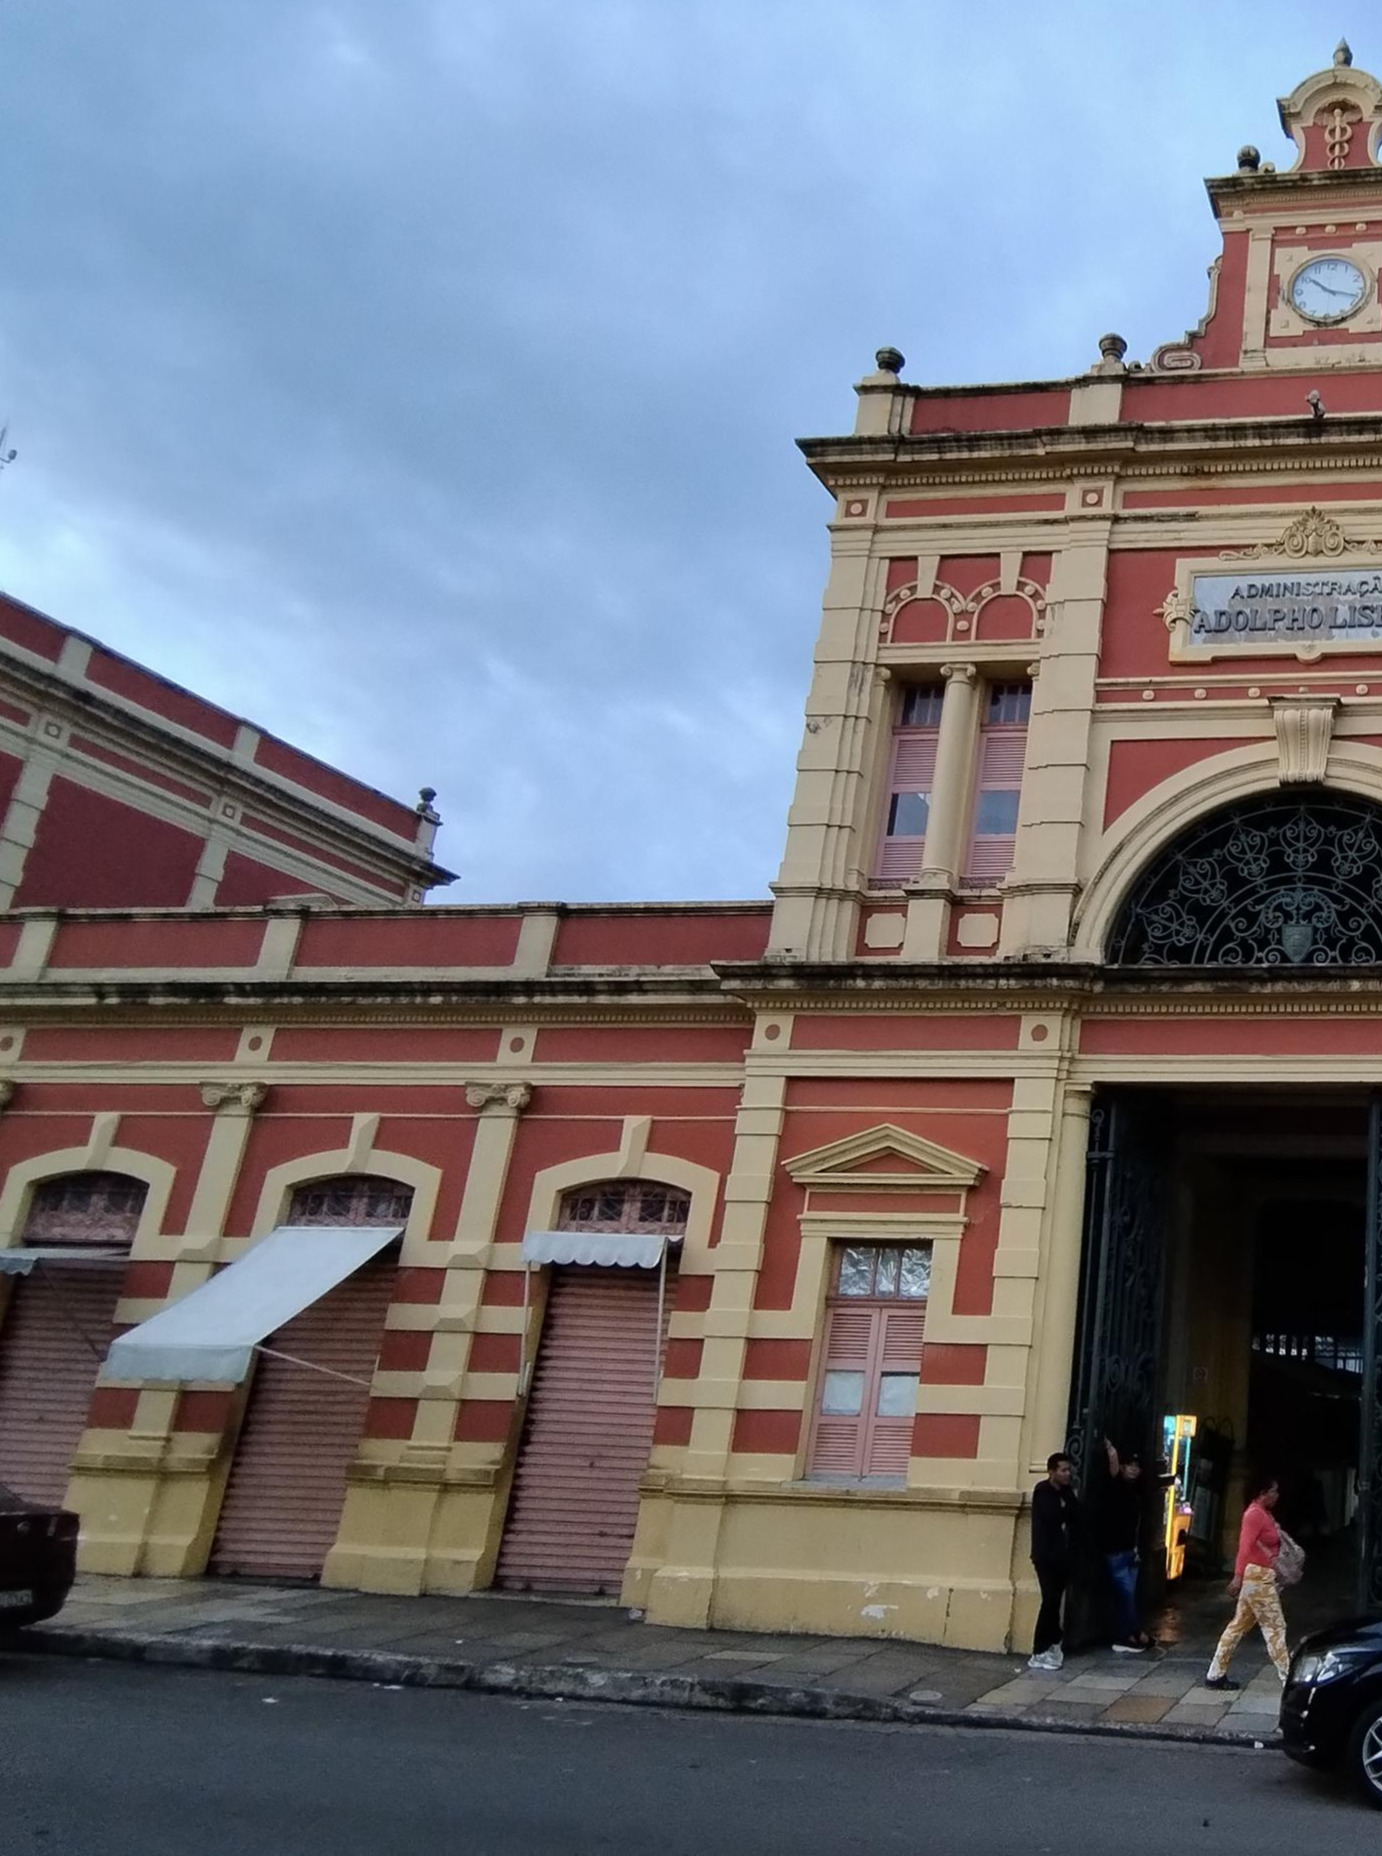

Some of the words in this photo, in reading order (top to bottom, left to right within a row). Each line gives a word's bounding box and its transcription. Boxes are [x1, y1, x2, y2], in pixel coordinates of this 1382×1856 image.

[1314, 266, 1321, 274] 11
[1301, 276, 1311, 284] 10
[1353, 274, 1361, 282] 2
[1194, 606, 1324, 633] ADOLPHO
